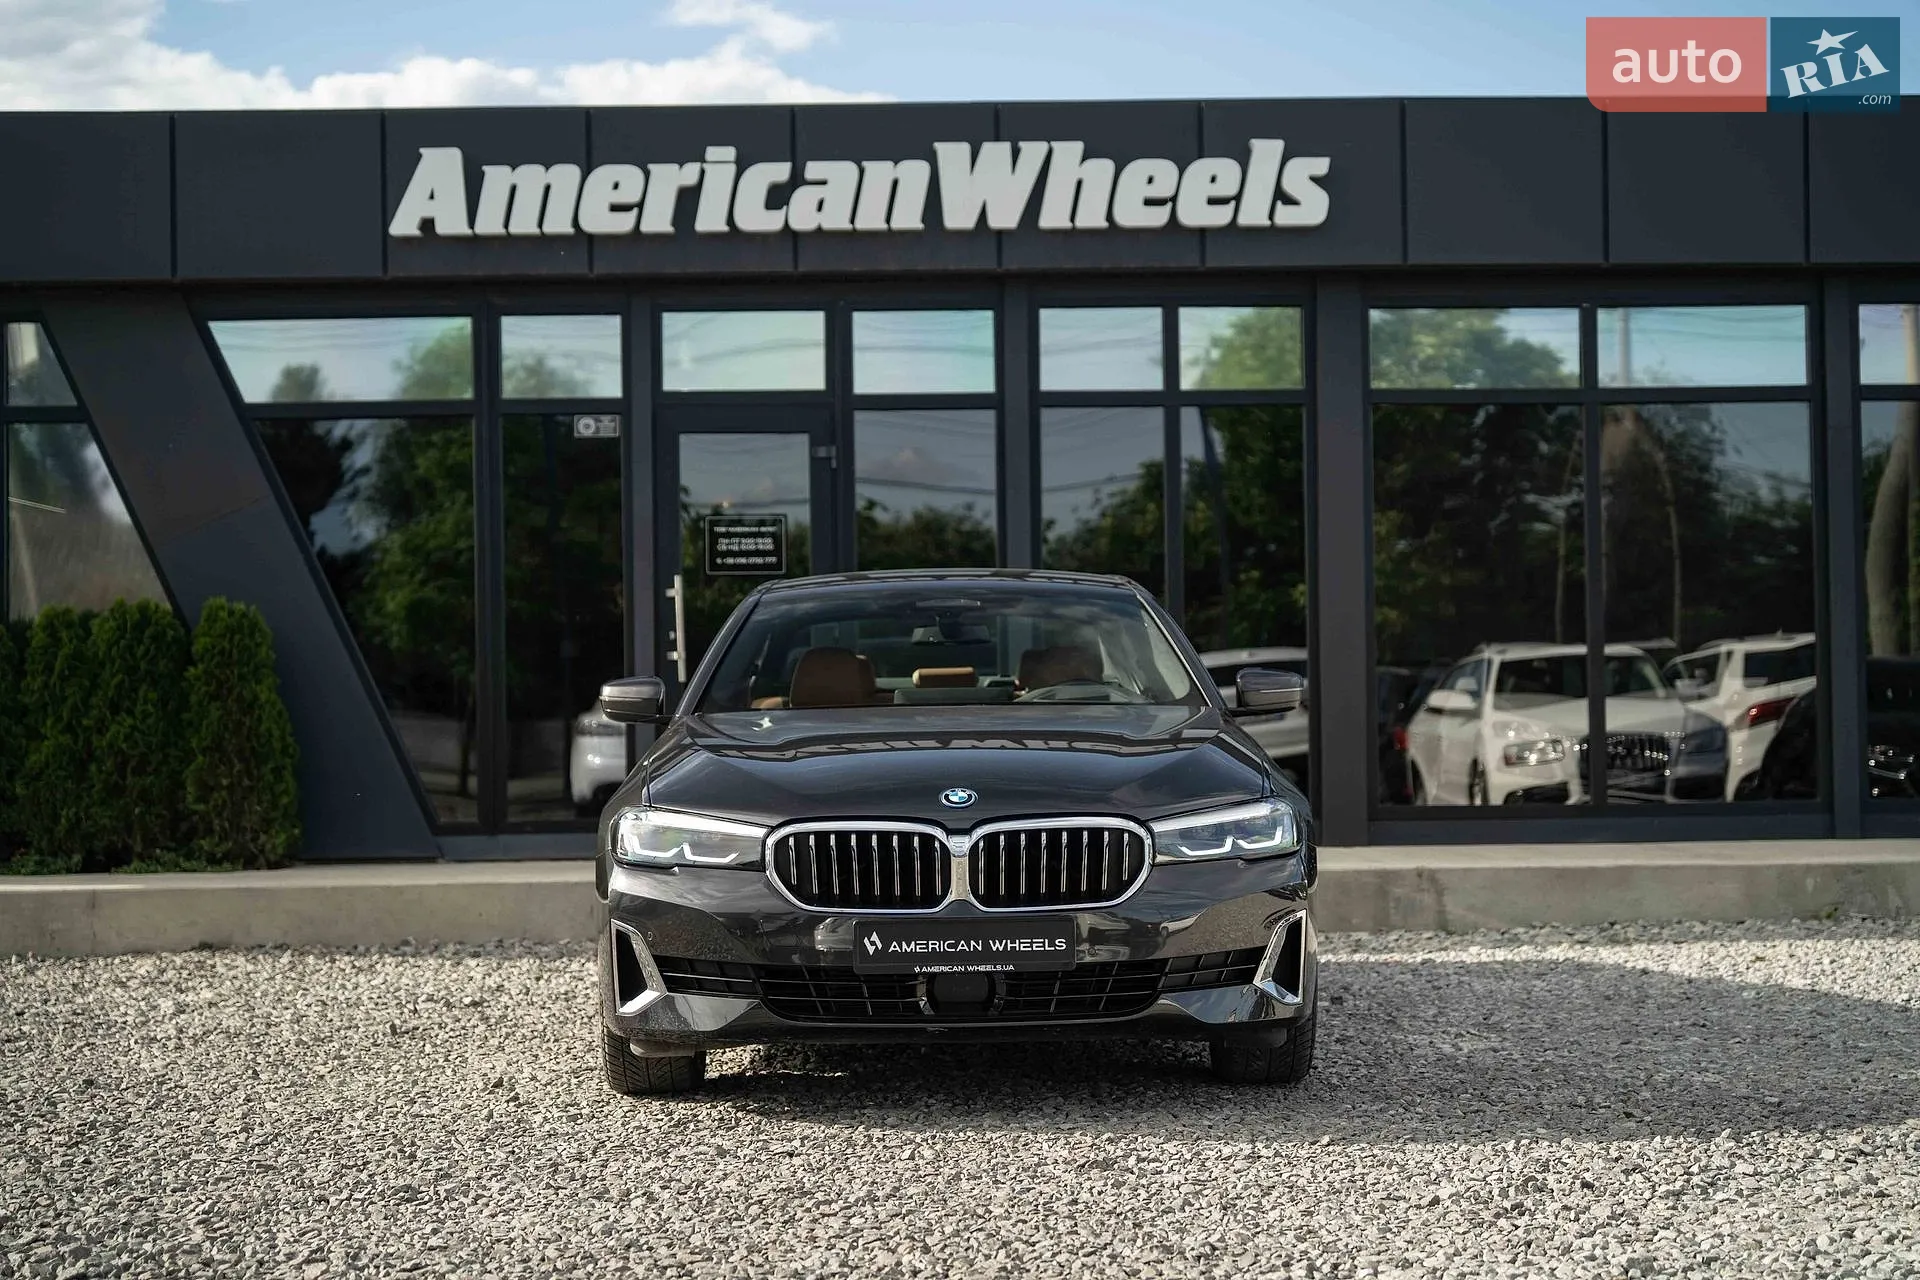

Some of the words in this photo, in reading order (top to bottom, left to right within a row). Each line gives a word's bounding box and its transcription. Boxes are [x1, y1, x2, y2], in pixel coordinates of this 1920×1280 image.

[388, 138, 1331, 238] AmericanWheels
[889, 940, 982, 953] AMERICAN
[989, 939, 1067, 951] WHEELS
[921, 965, 965, 973] AMERICAN
[966, 964, 1015, 972] WHEELS.UA
